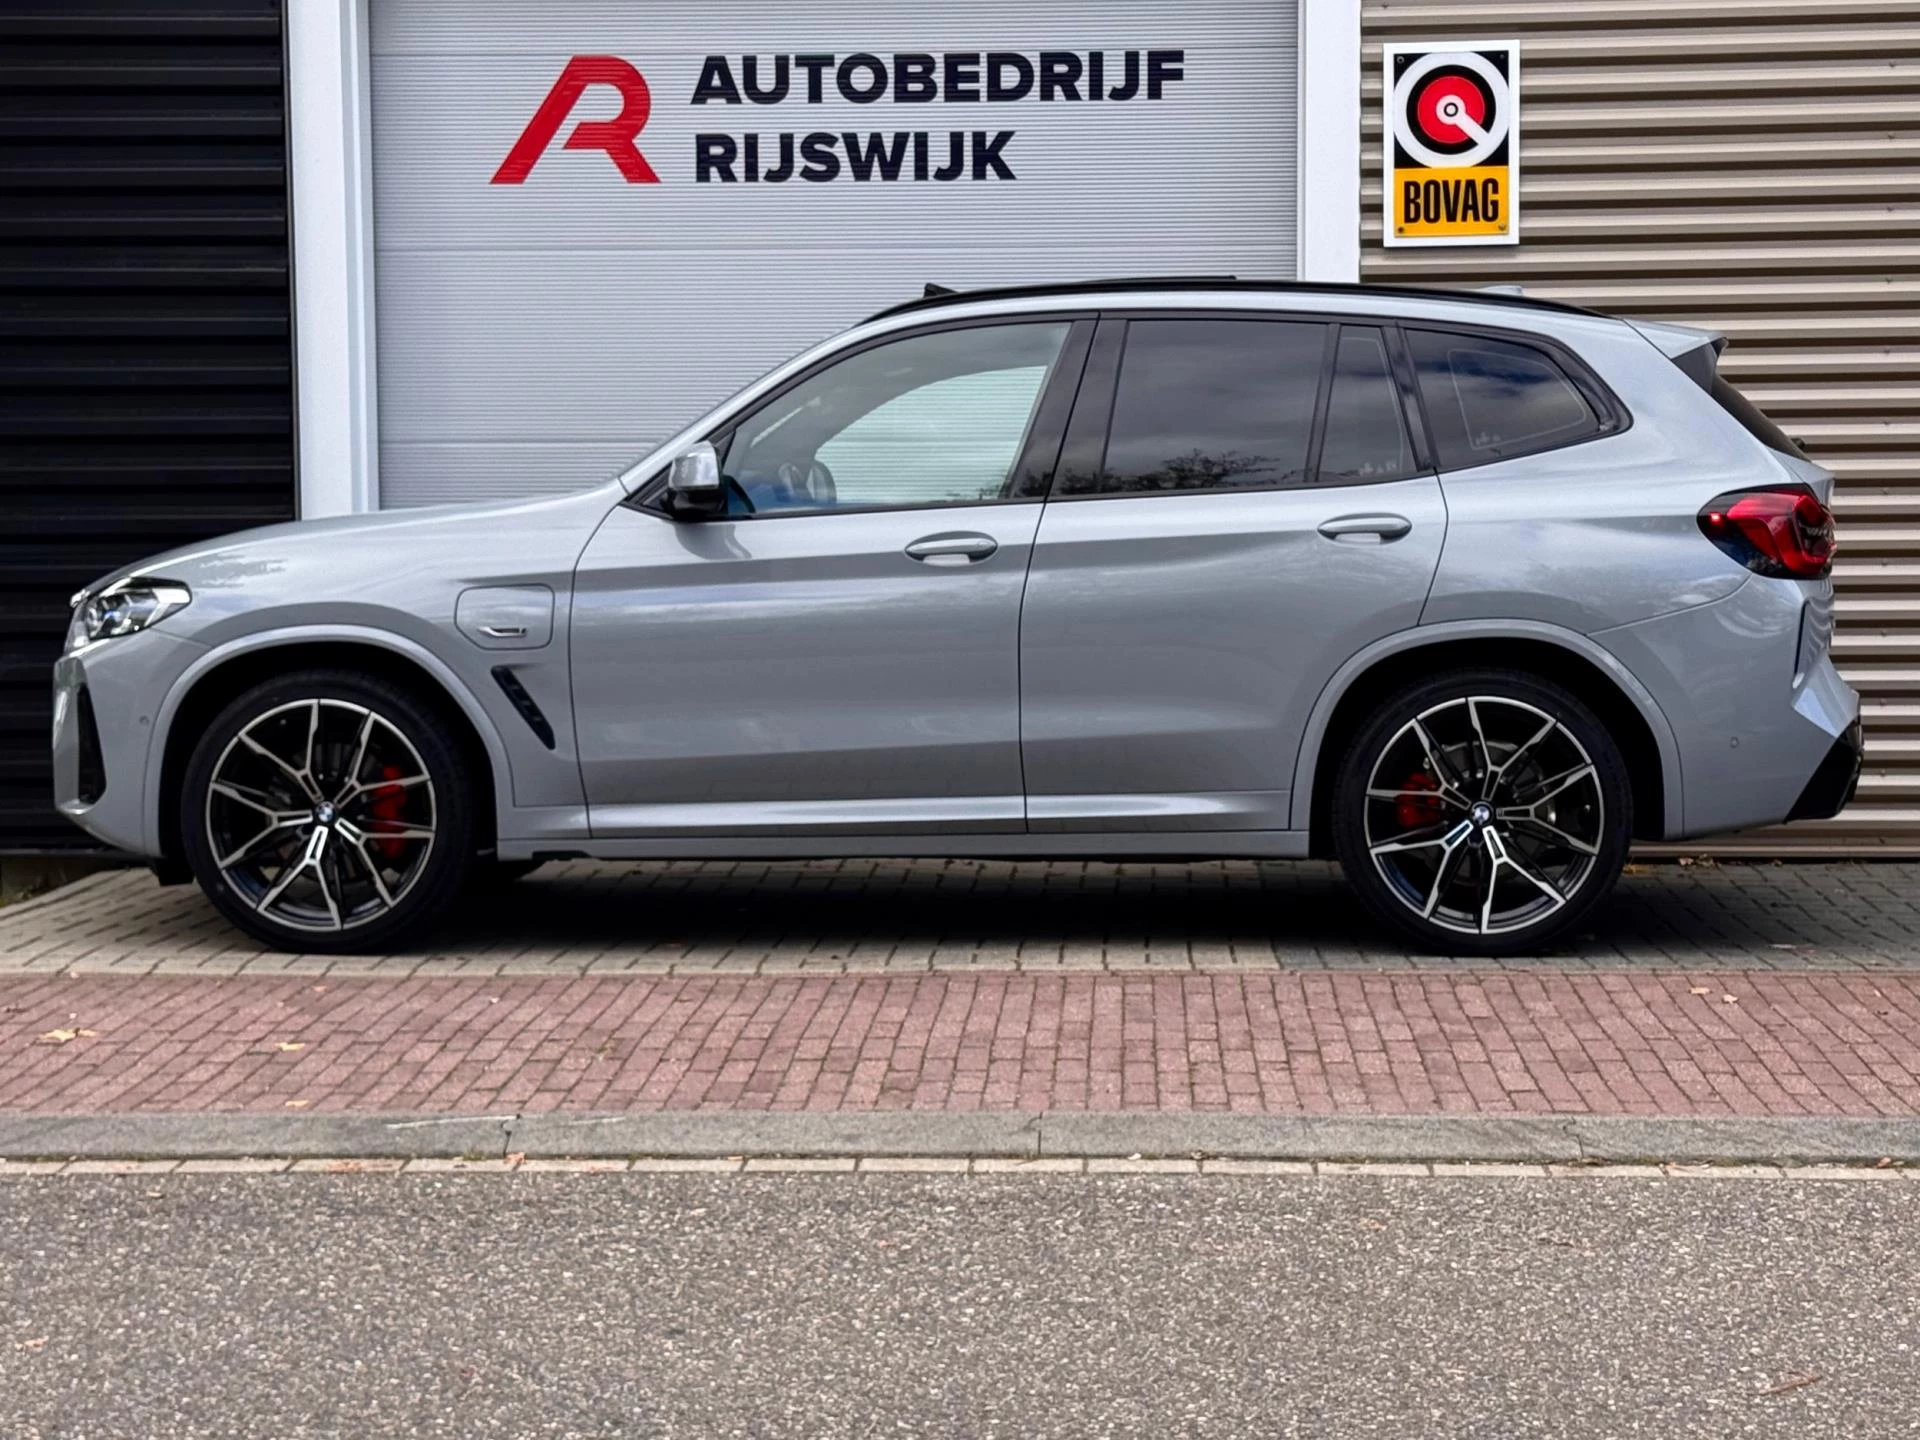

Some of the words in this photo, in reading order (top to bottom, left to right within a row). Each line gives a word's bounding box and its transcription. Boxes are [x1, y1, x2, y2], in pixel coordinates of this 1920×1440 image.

[690, 49, 1185, 105] AUTOBEDRIJF
[695, 130, 1017, 183] RIJSWIJK
[1403, 177, 1499, 224] BOVAG
